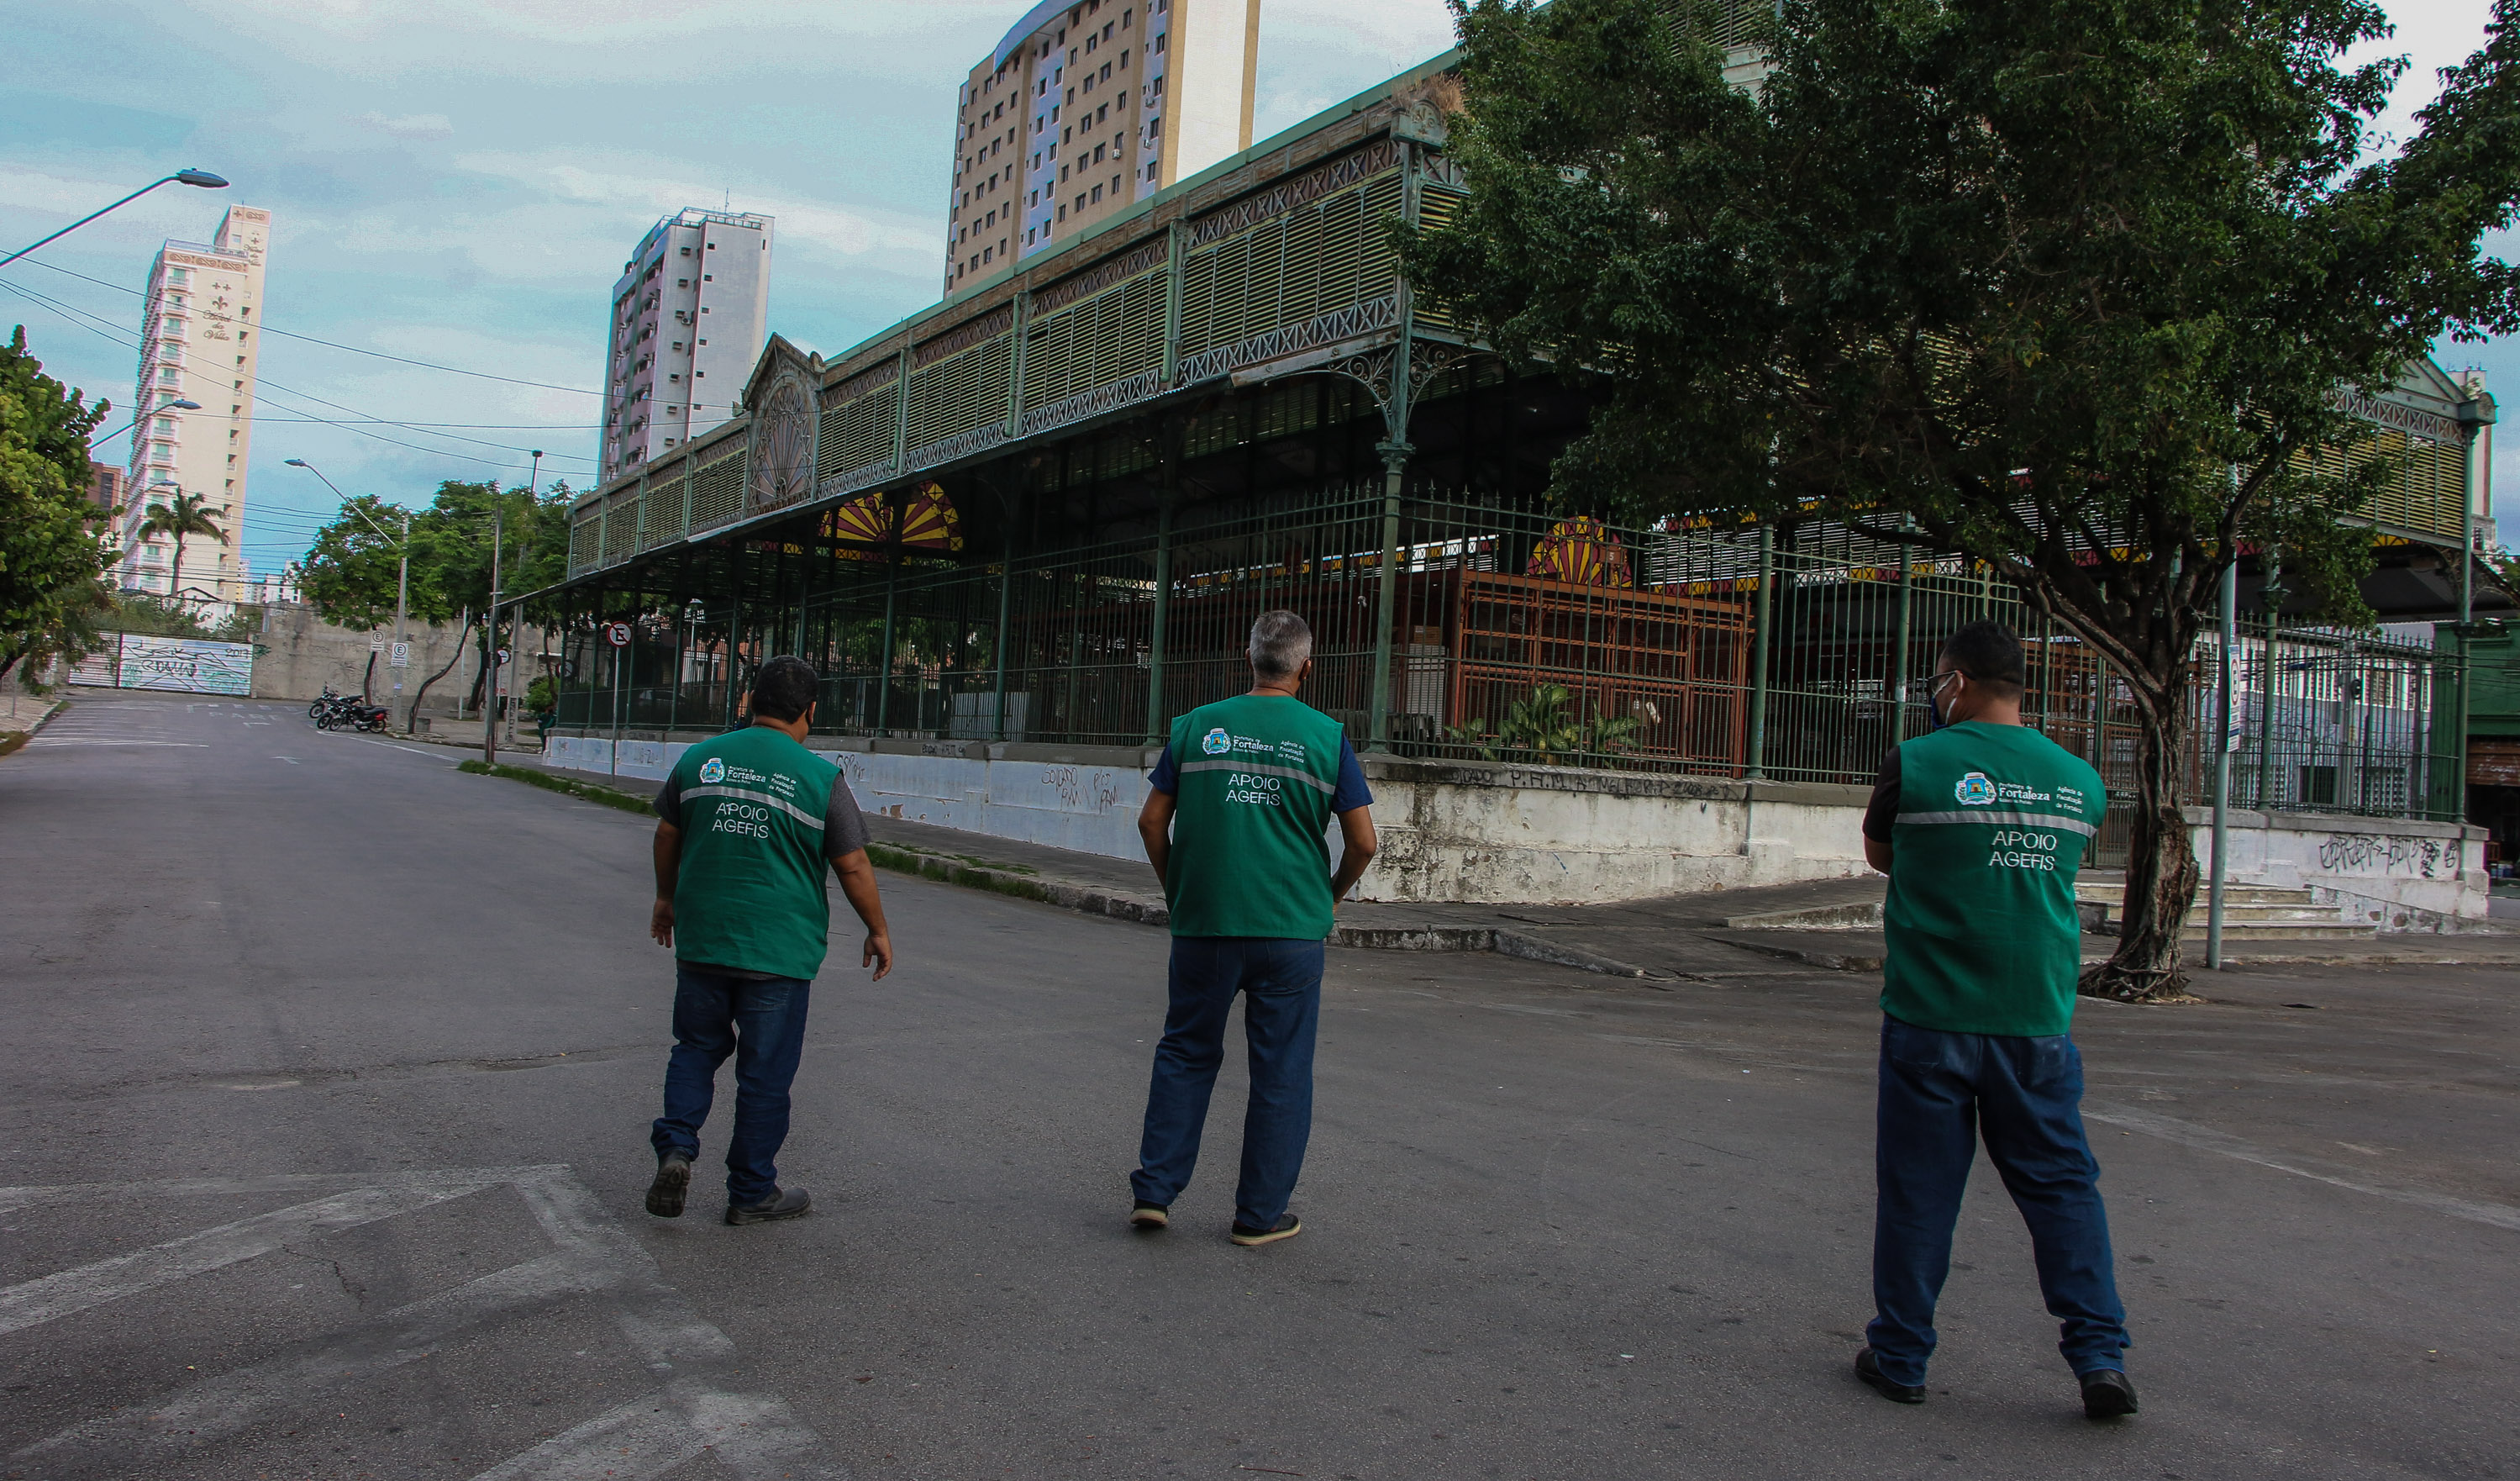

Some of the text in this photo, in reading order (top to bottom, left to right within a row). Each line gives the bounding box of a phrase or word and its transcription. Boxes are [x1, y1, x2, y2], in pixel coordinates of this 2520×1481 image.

[397, 646, 403, 654] E
[1233, 739, 1274, 752] Fortaleza
[727, 769, 766, 783] Fortaleza
[1228, 773, 1281, 791] APOIO
[1225, 789, 1281, 806] AGEFIS
[1998, 788, 2050, 801] Fortaleza
[715, 802, 769, 821] APOIO
[712, 819, 769, 839] AGEFIS
[1991, 830, 2057, 851] APOIO
[1988, 851, 2055, 871] AGEFIS
